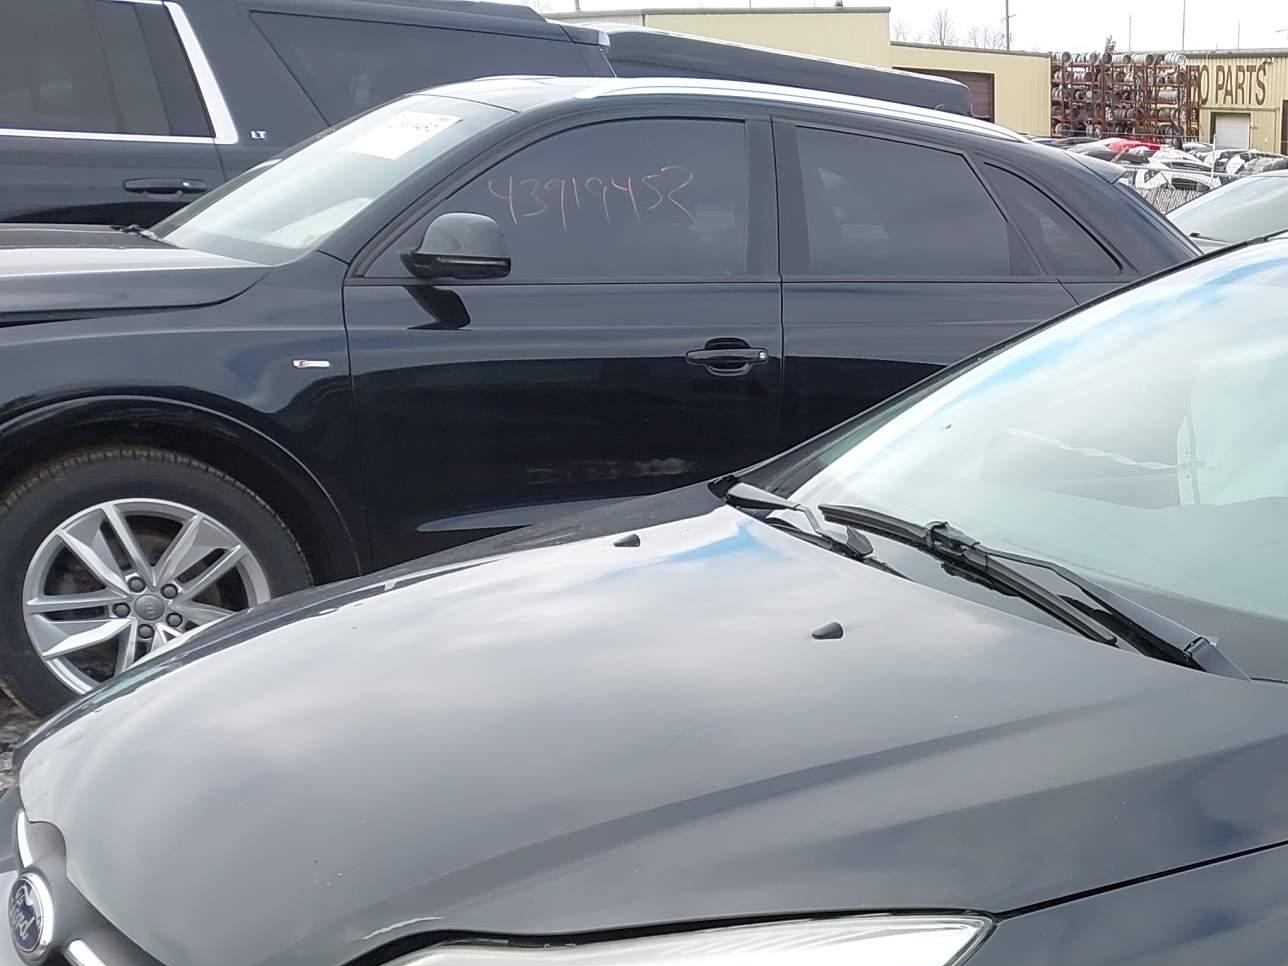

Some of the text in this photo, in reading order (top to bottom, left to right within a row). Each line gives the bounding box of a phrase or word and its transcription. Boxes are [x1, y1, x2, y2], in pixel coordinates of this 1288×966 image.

[1215, 64, 1267, 105] PARTS
[250, 130, 267, 139] LT
[488, 165, 698, 231] 43919452
